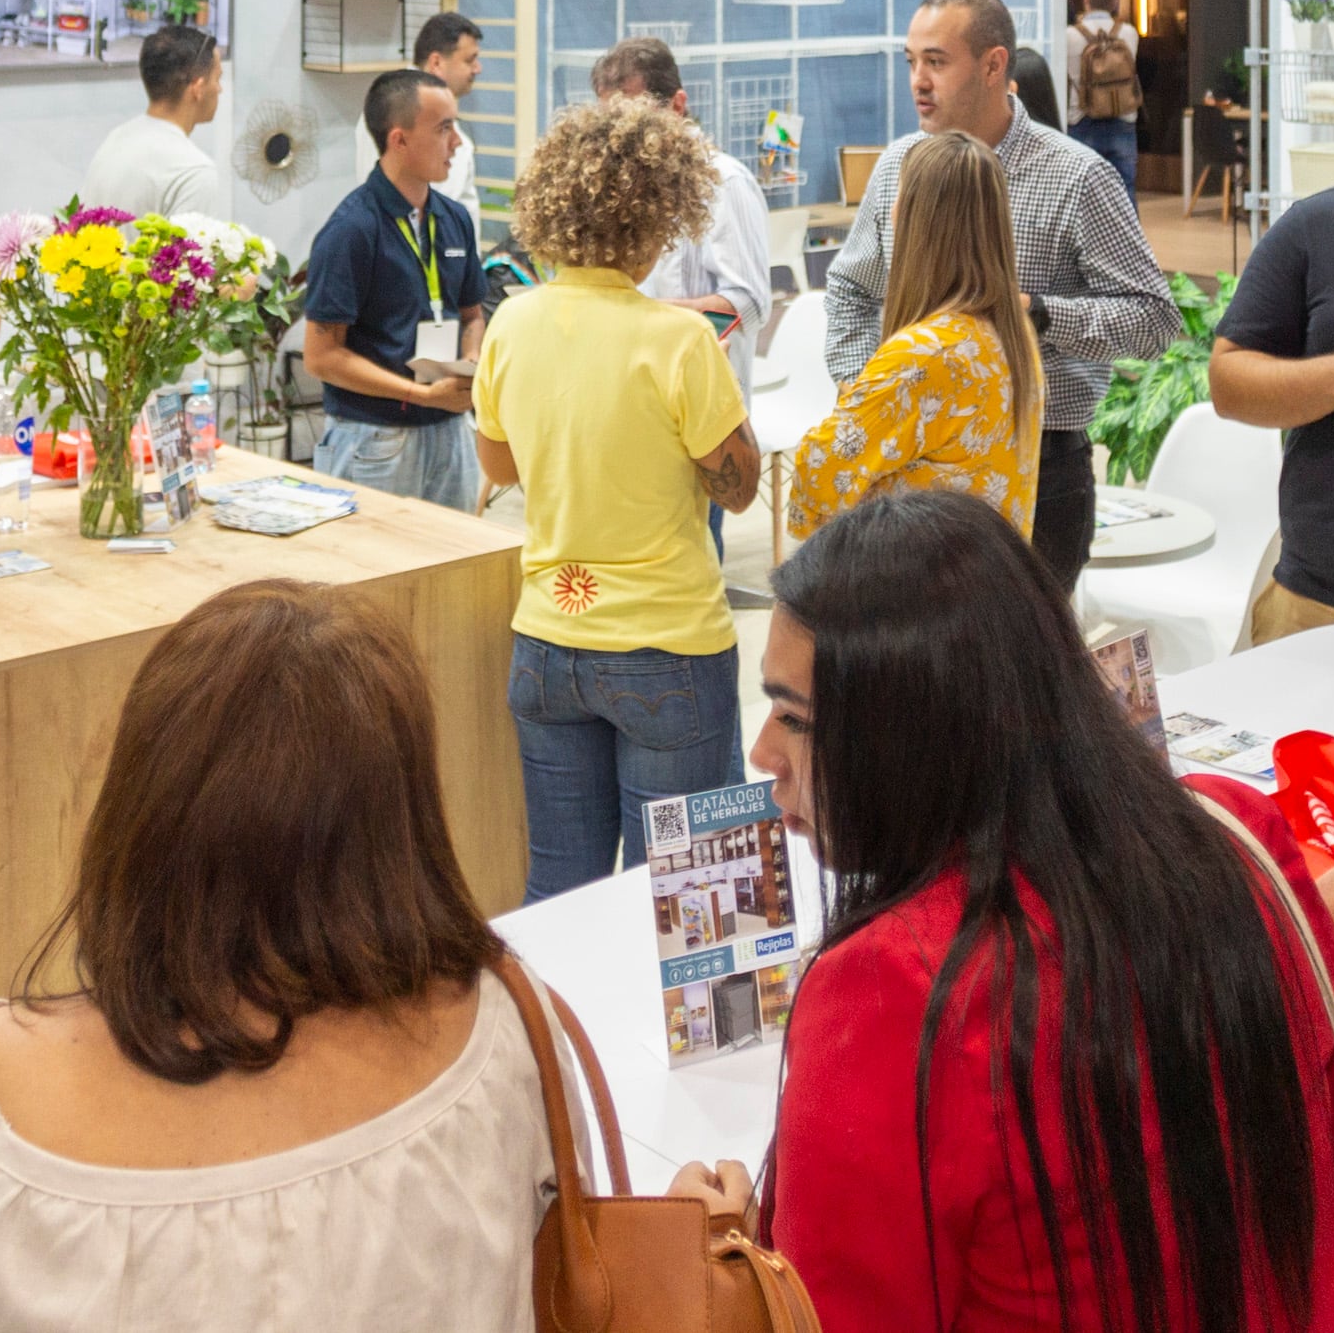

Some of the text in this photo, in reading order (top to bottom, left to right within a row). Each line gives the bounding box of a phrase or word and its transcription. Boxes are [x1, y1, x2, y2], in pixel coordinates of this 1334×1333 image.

[691, 786, 765, 814] CATÁLOGO
[693, 800, 766, 824] DE HERRAJES
[756, 935, 793, 954] Rejiplas
